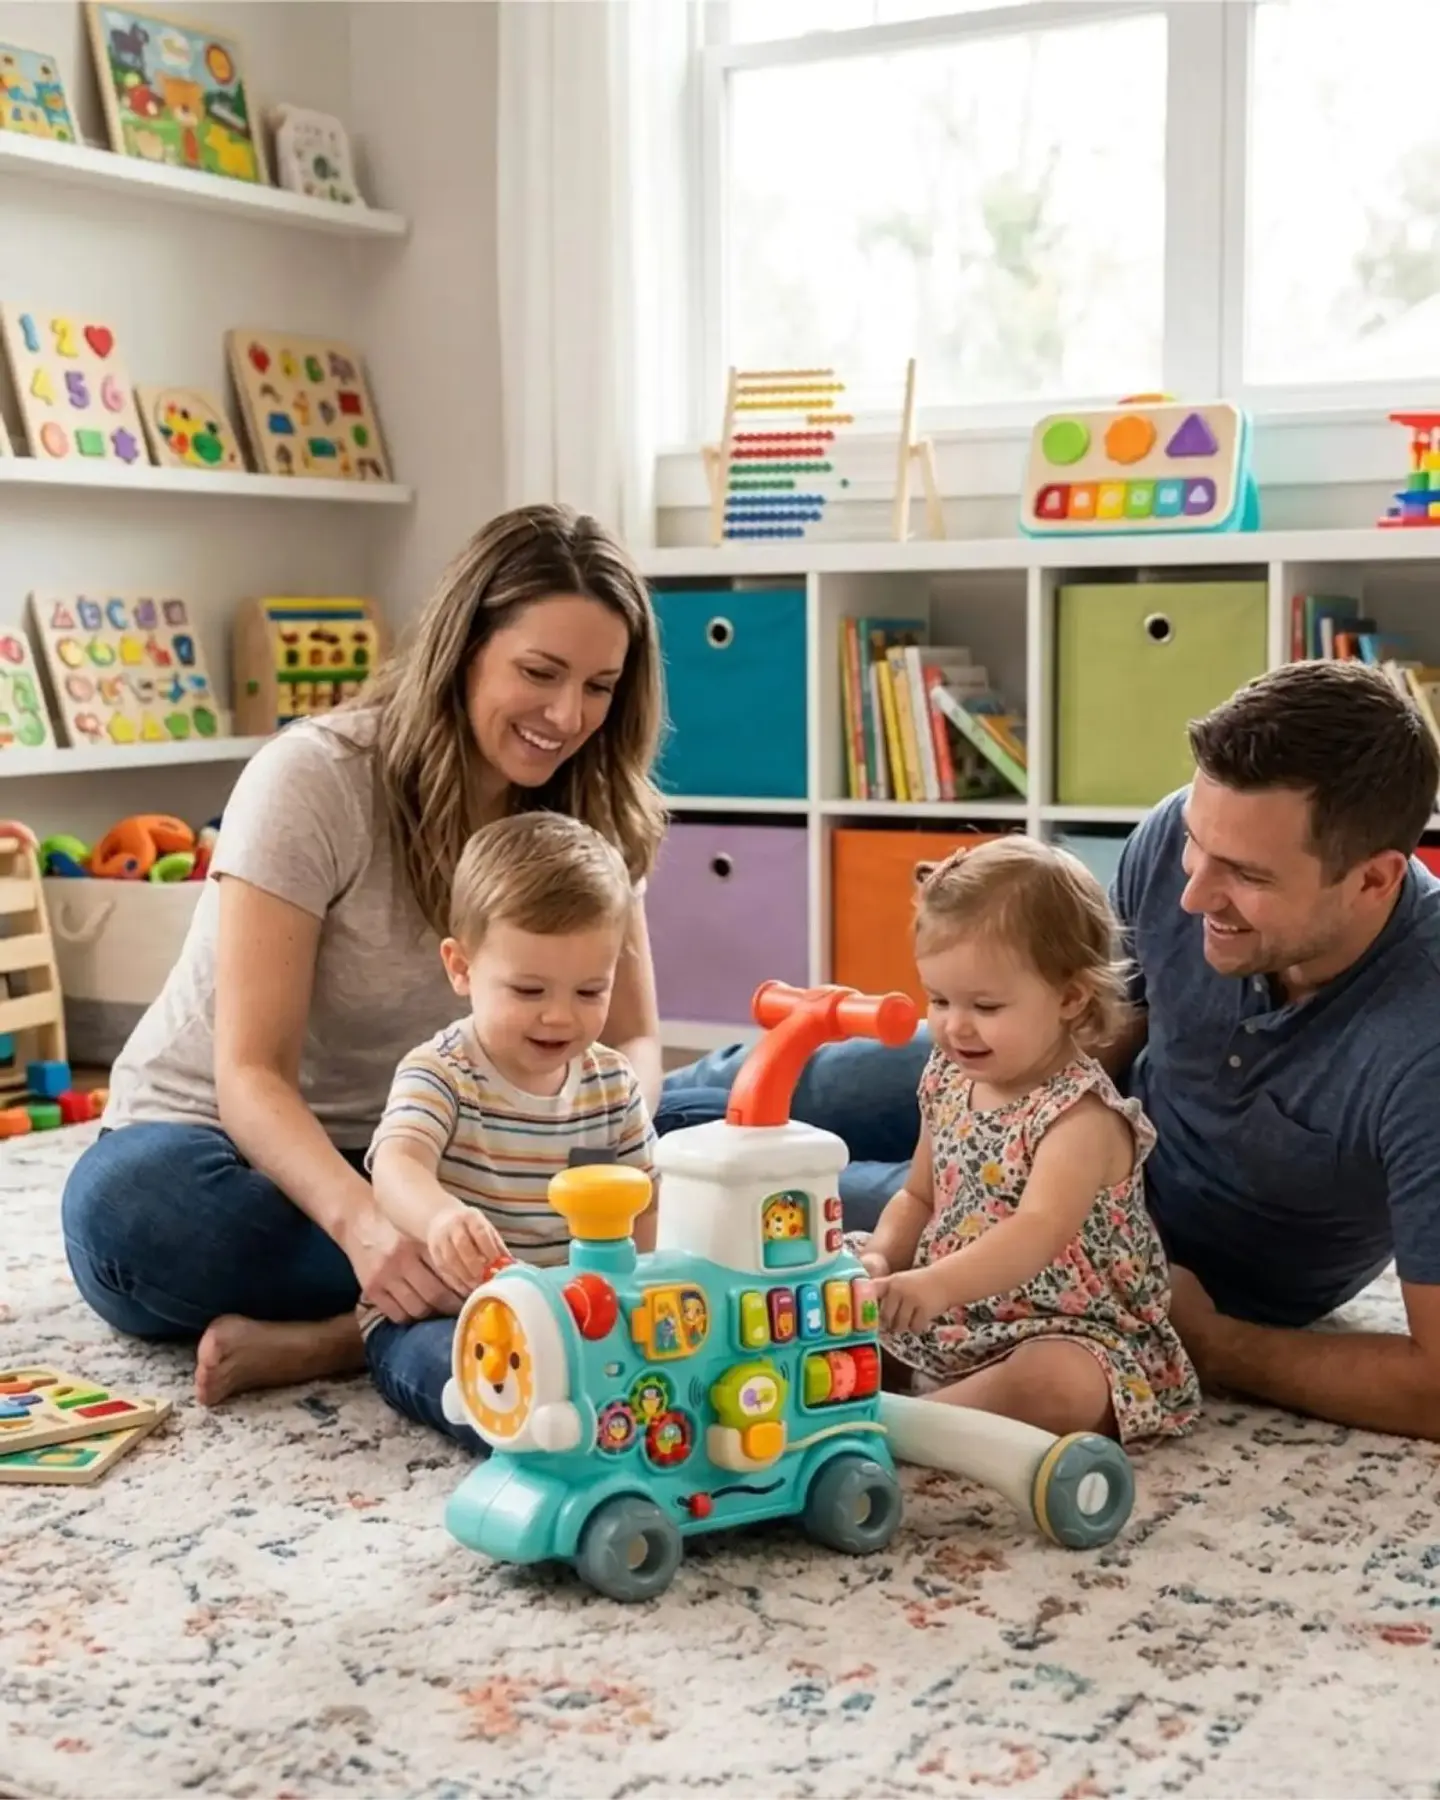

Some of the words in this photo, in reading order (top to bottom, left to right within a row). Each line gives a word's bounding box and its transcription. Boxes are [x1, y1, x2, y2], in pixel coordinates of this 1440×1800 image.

[19, 313, 40, 353] 1
[51, 318, 79, 358] 2
[30, 367, 54, 406] 4
[65, 370, 90, 409] 5
[101, 374, 126, 413] 6
